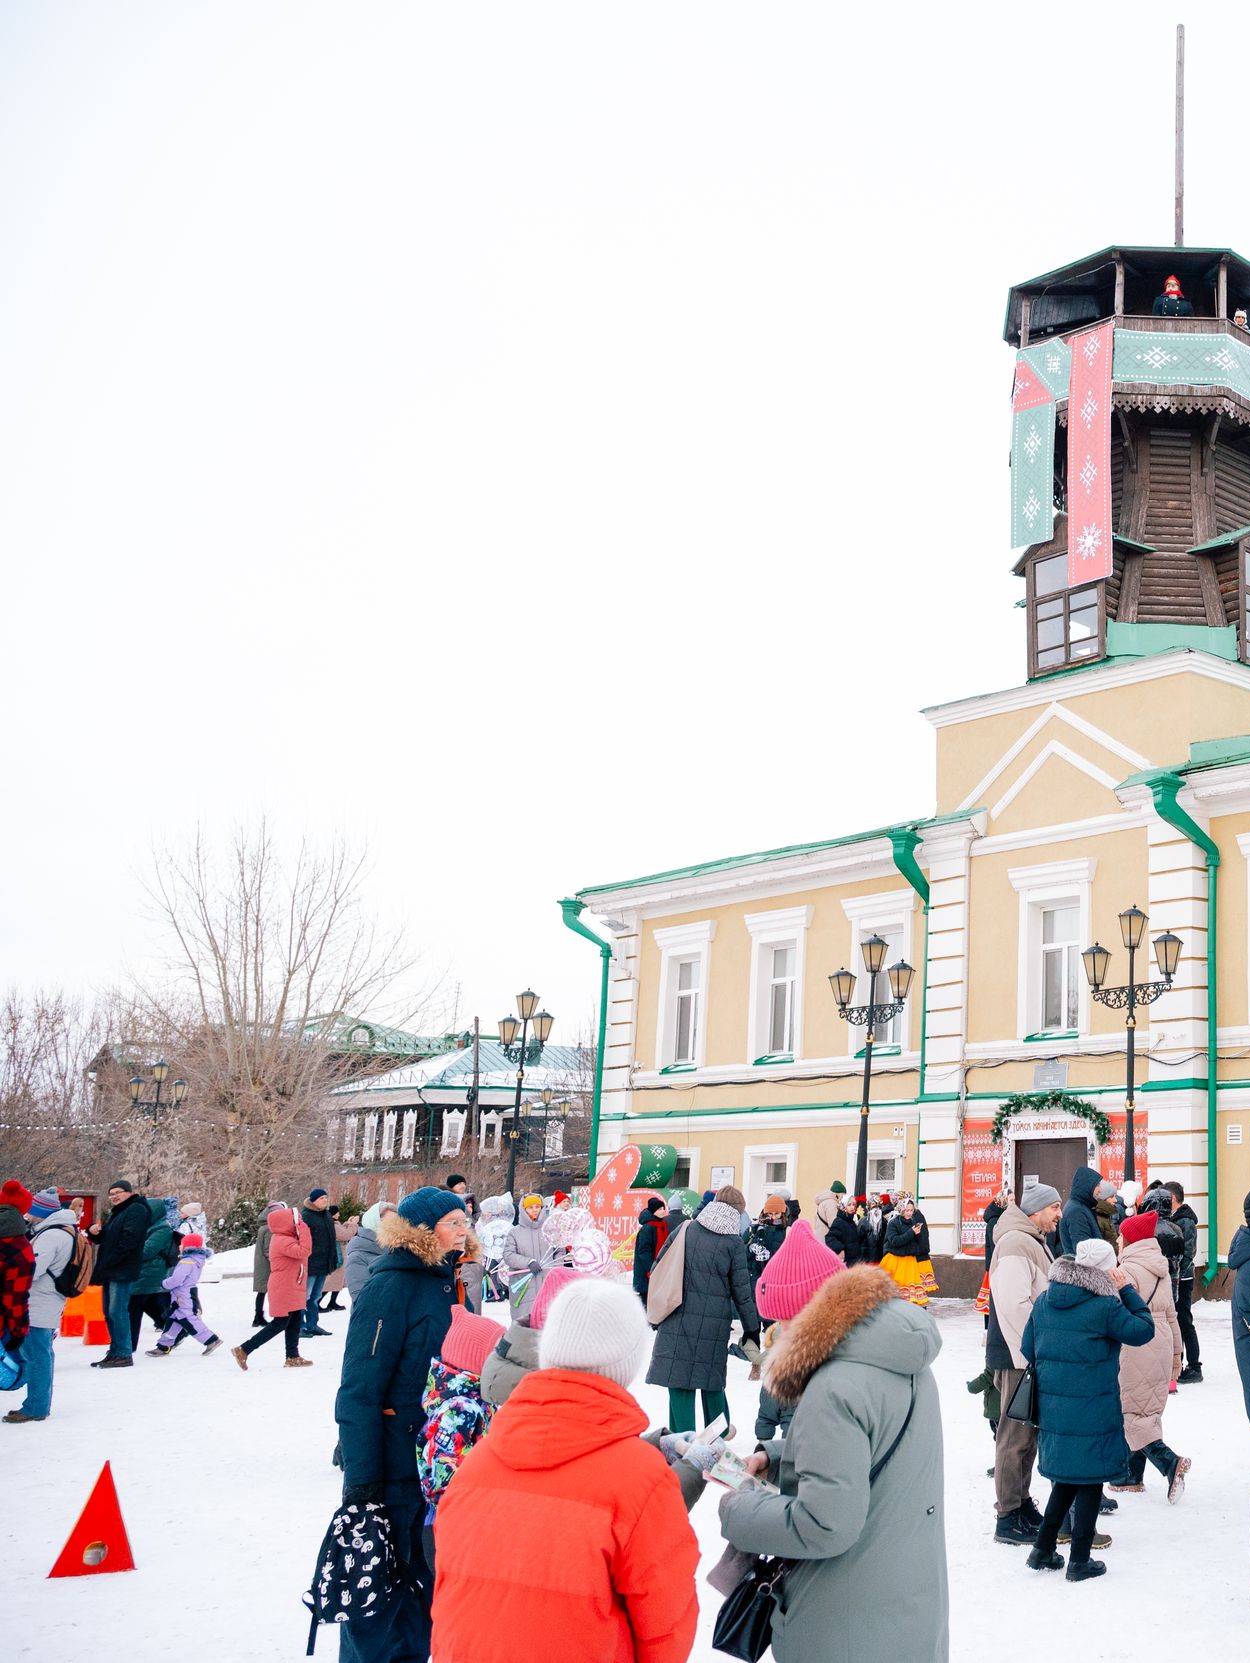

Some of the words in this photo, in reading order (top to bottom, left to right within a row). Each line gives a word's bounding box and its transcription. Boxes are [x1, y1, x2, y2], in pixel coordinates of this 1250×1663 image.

[1069, 1120, 1087, 1130] ЗДЕСЬ
[1108, 1169, 1115, 1179] В
[975, 1188, 993, 1198] ЗИМА
